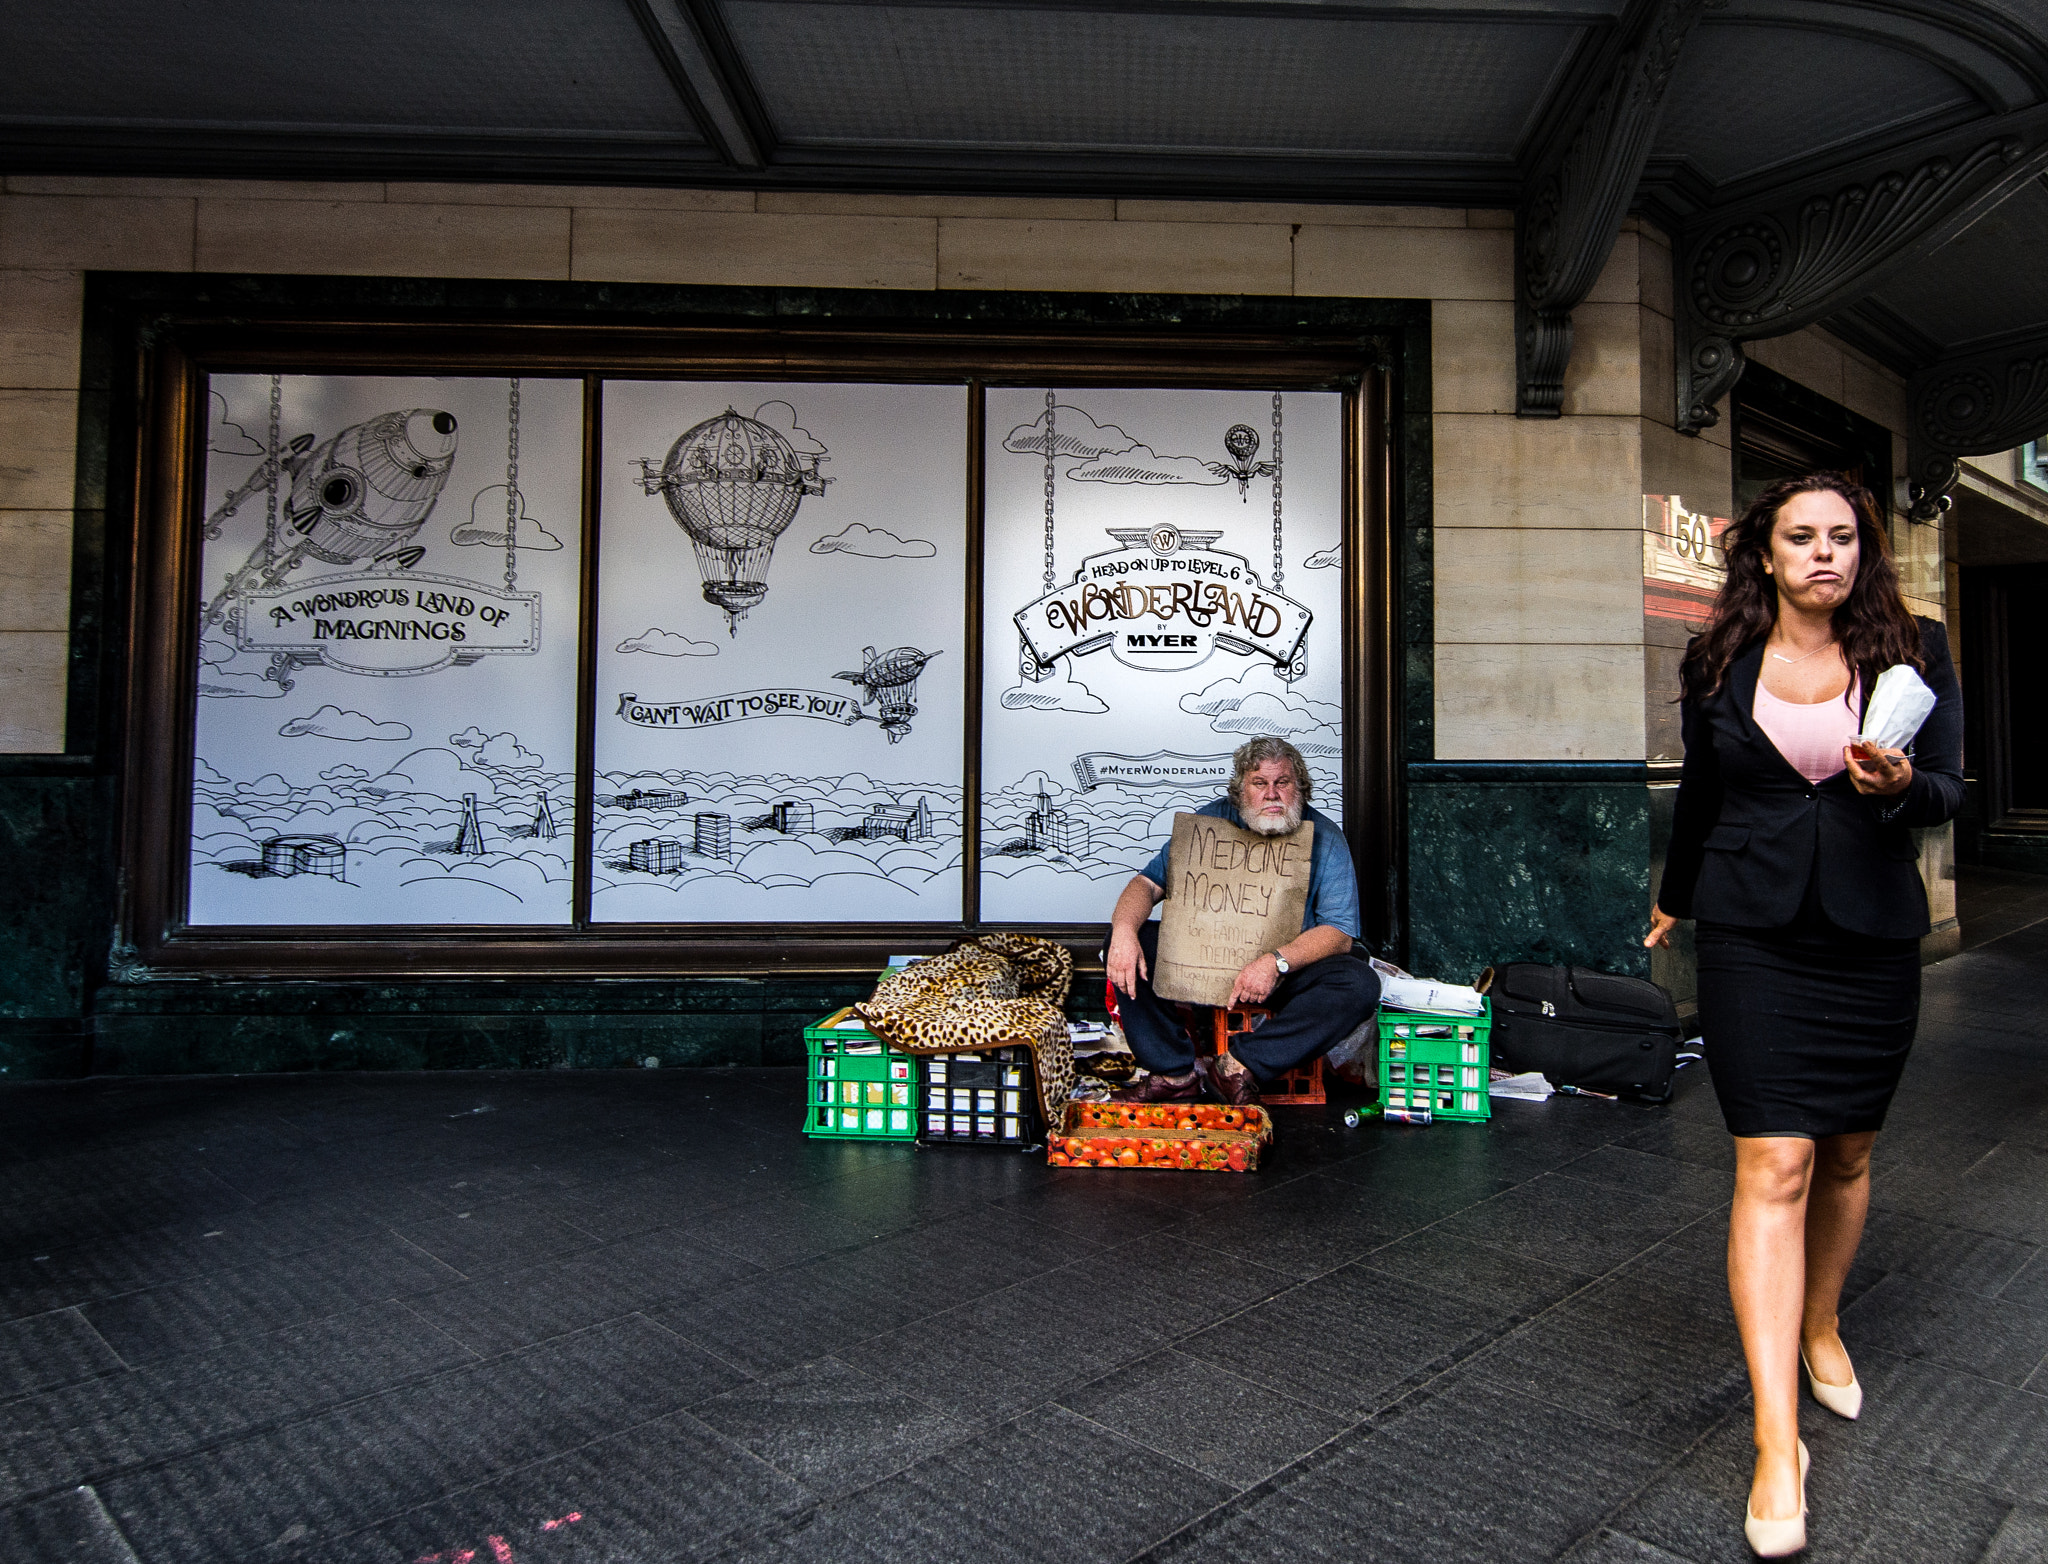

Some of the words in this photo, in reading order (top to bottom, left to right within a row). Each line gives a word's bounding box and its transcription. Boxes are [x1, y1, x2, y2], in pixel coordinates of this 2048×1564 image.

[1676, 515, 1706, 561] 50
[1091, 563, 1129, 579] HEAD
[1130, 559, 1148, 571] ON
[1151, 559, 1169, 571] UP
[1171, 560, 1186, 571] TO
[1188, 559, 1229, 578] LEVEL
[1230, 567, 1240, 580] 6
[269, 606, 294, 627] A
[292, 588, 409, 617] WONDROUS
[415, 590, 475, 617] LAND
[480, 605, 510, 628] OF
[1046, 580, 1282, 638] WONDERLAND
[313, 619, 466, 641] IMAGININGS
[1127, 634, 1197, 647] MYER
[683, 699, 734, 724] WAIT
[736, 696, 762, 716] TO
[764, 693, 803, 714] SEE
[806, 695, 847, 718] YOU!
[1188, 824, 1299, 877] MEDICINE
[1183, 871, 1273, 917] MONEY
[1213, 921, 1264, 945] FAMILY
